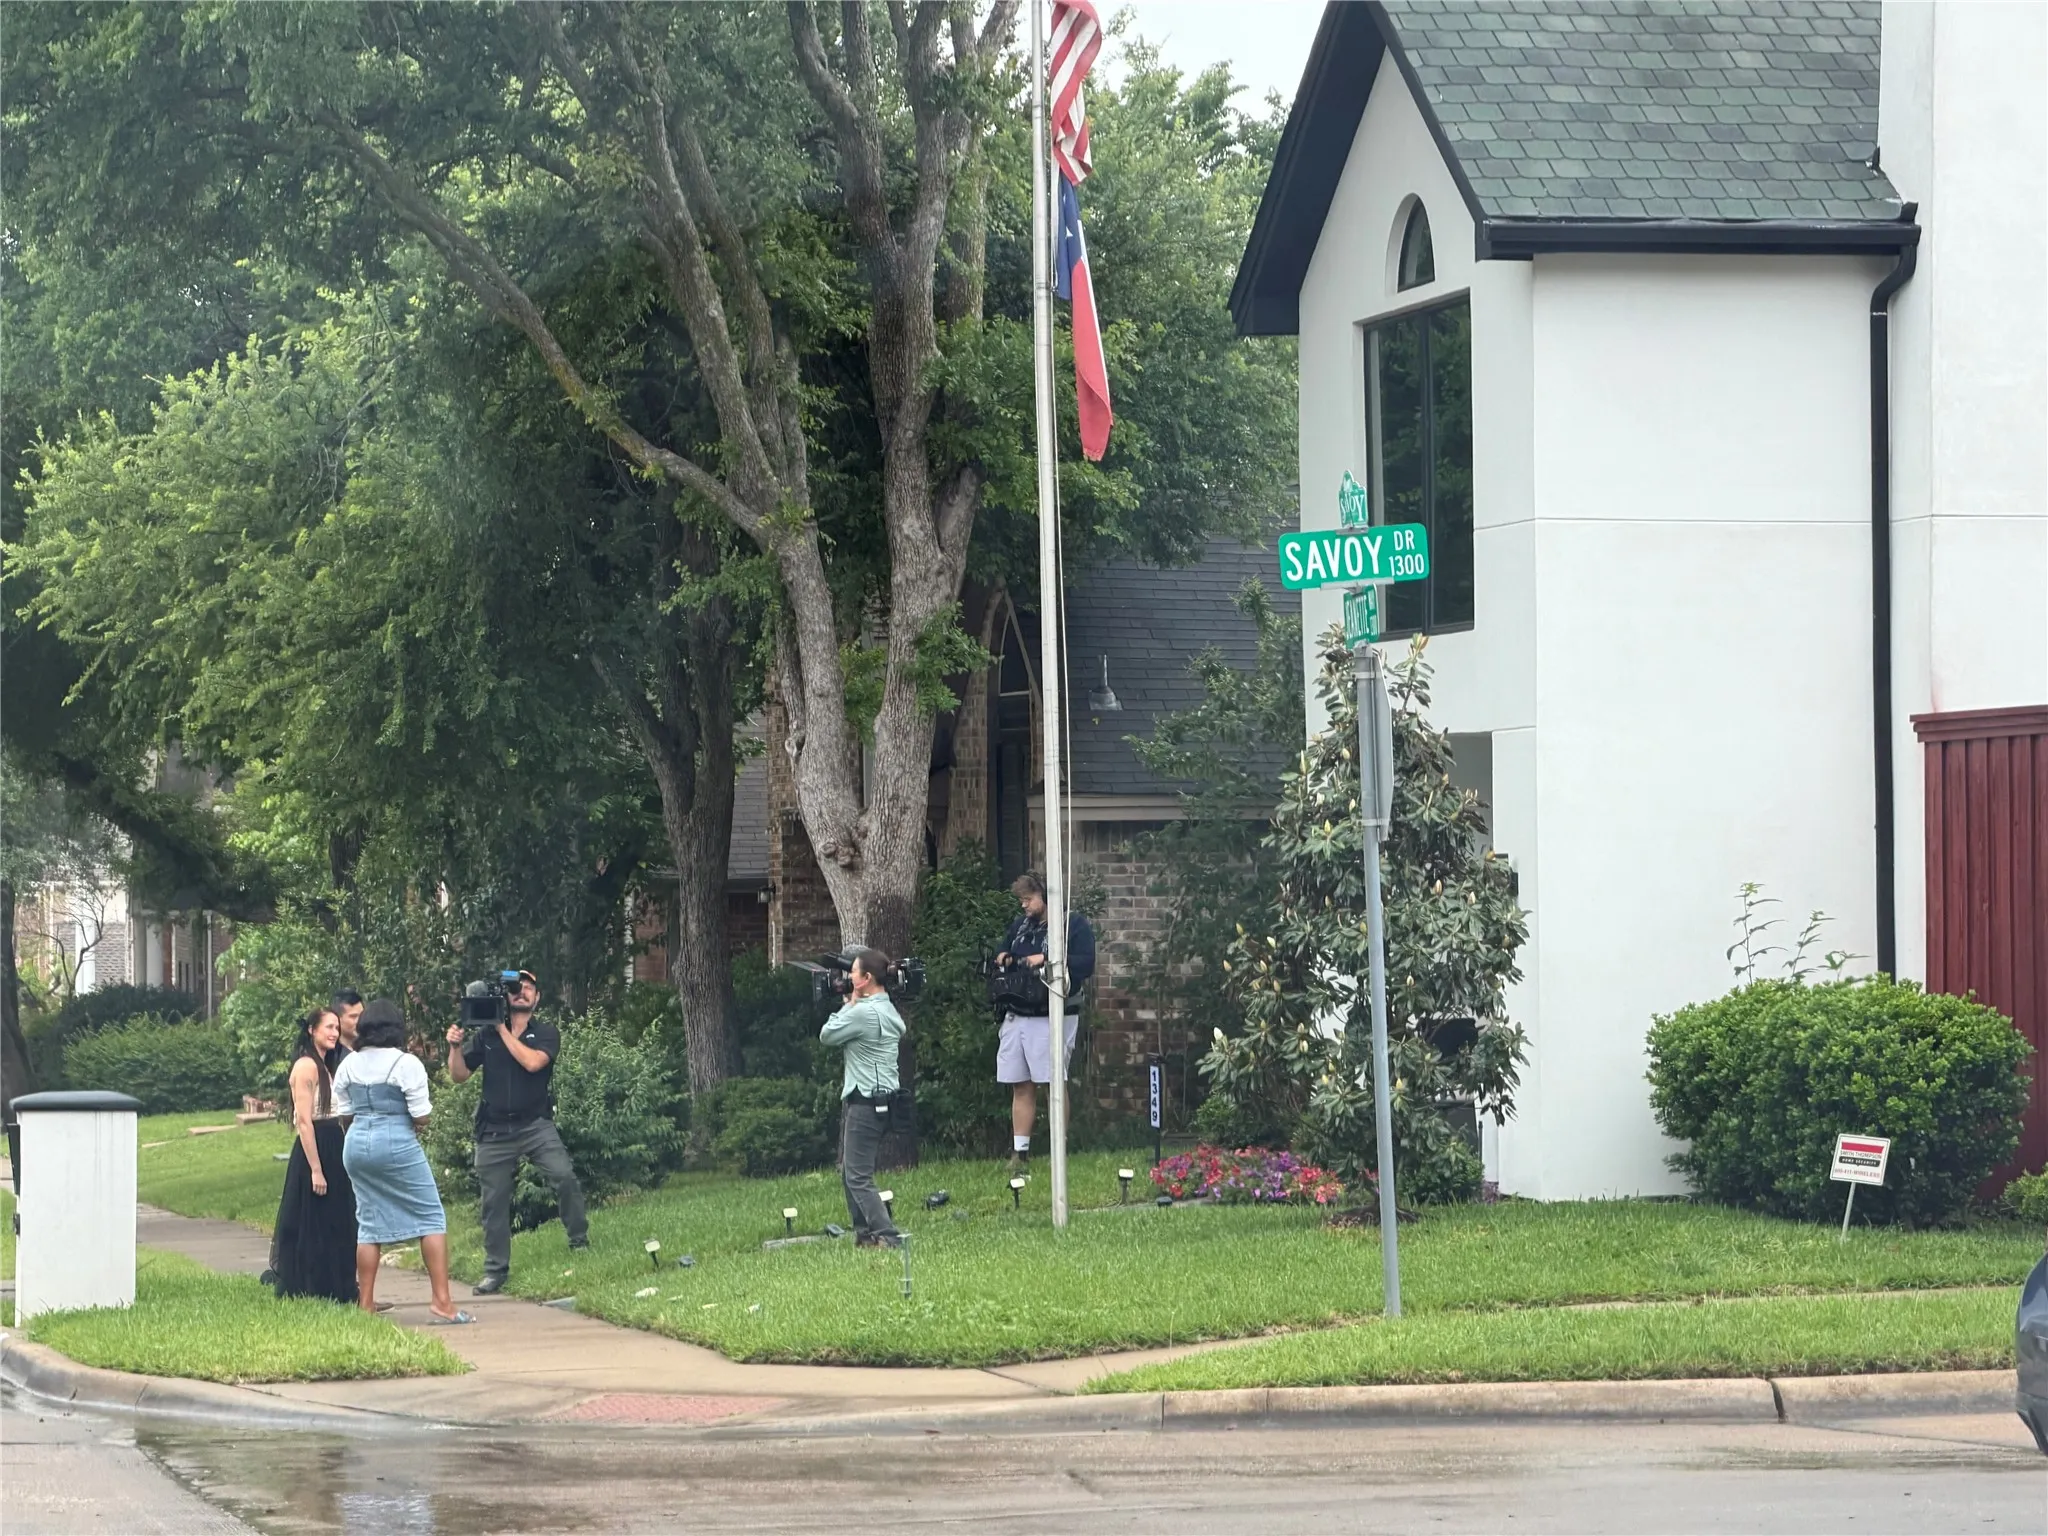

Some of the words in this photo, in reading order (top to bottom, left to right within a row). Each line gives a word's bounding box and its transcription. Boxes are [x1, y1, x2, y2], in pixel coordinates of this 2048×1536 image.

[1285, 535, 1383, 581] SAVOY
[1393, 529, 1415, 551] DR
[1388, 553, 1425, 576] 1300
